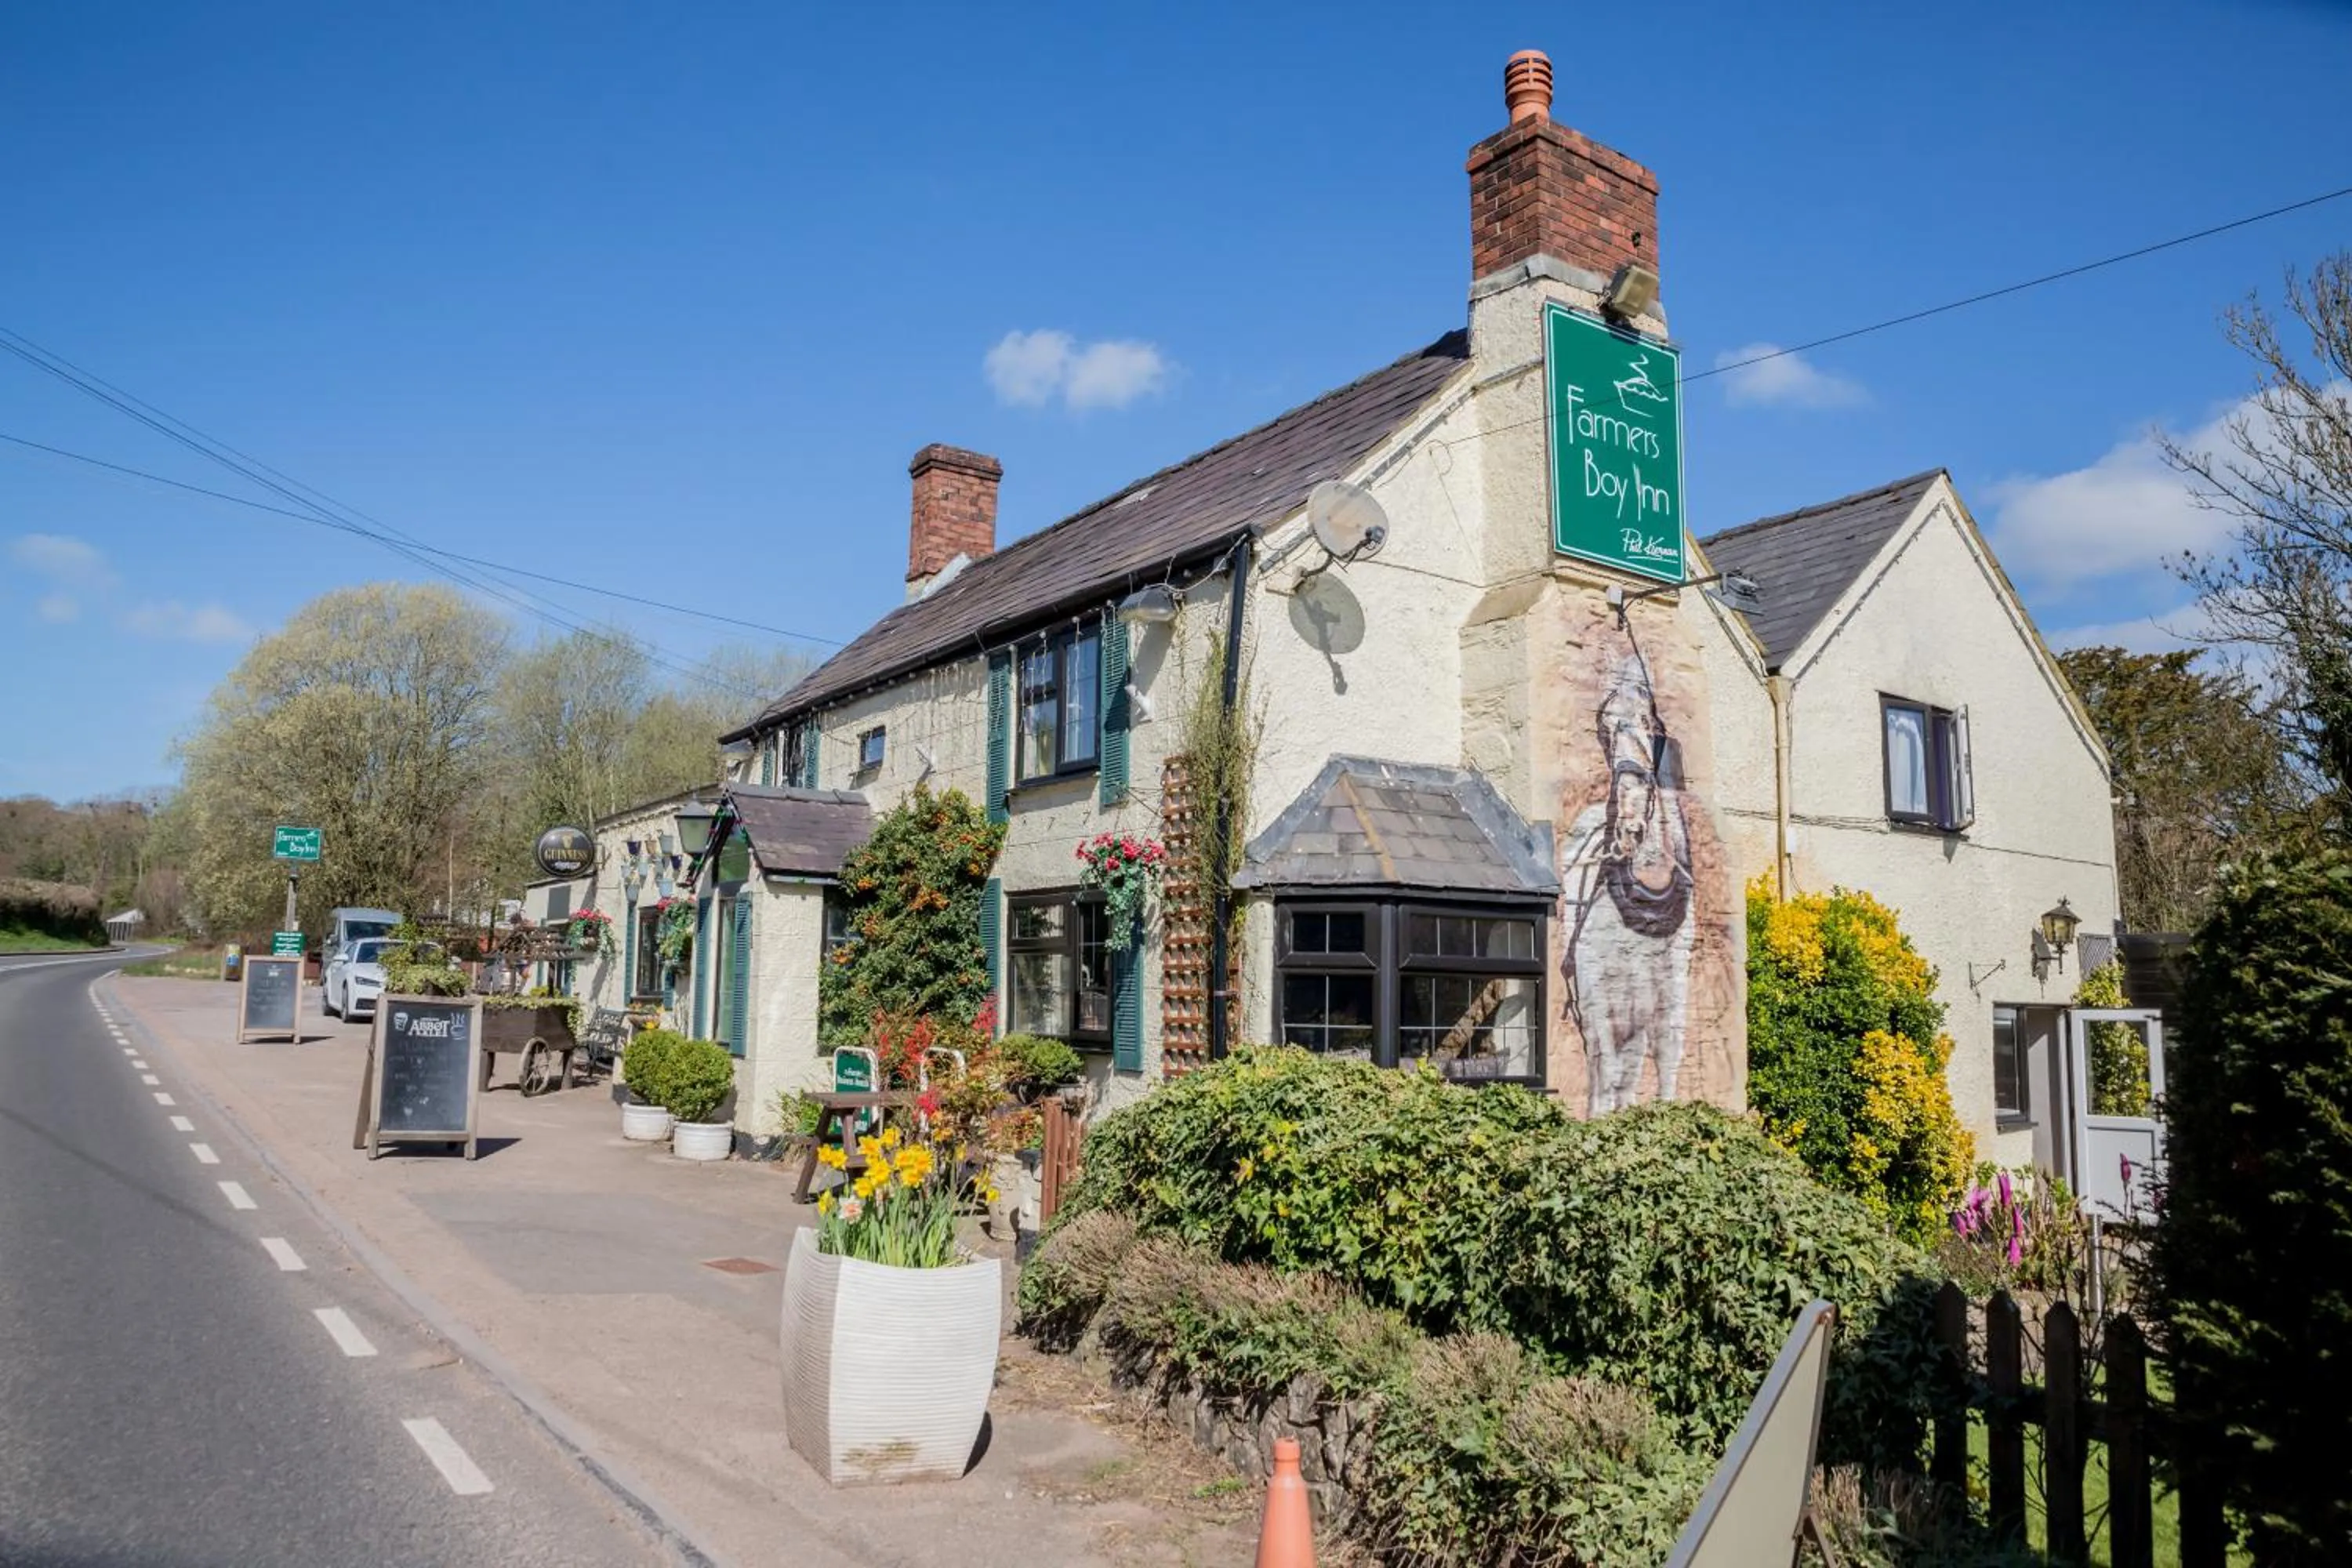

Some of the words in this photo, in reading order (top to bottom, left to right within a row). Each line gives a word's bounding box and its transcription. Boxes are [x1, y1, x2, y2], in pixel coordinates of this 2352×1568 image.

[1567, 383, 1660, 459] Farmers
[1584, 448, 1628, 519] Boy
[1633, 463, 1670, 521] Inn
[544, 848, 589, 862] GUINNESS
[408, 1019, 451, 1037] ABBOT
